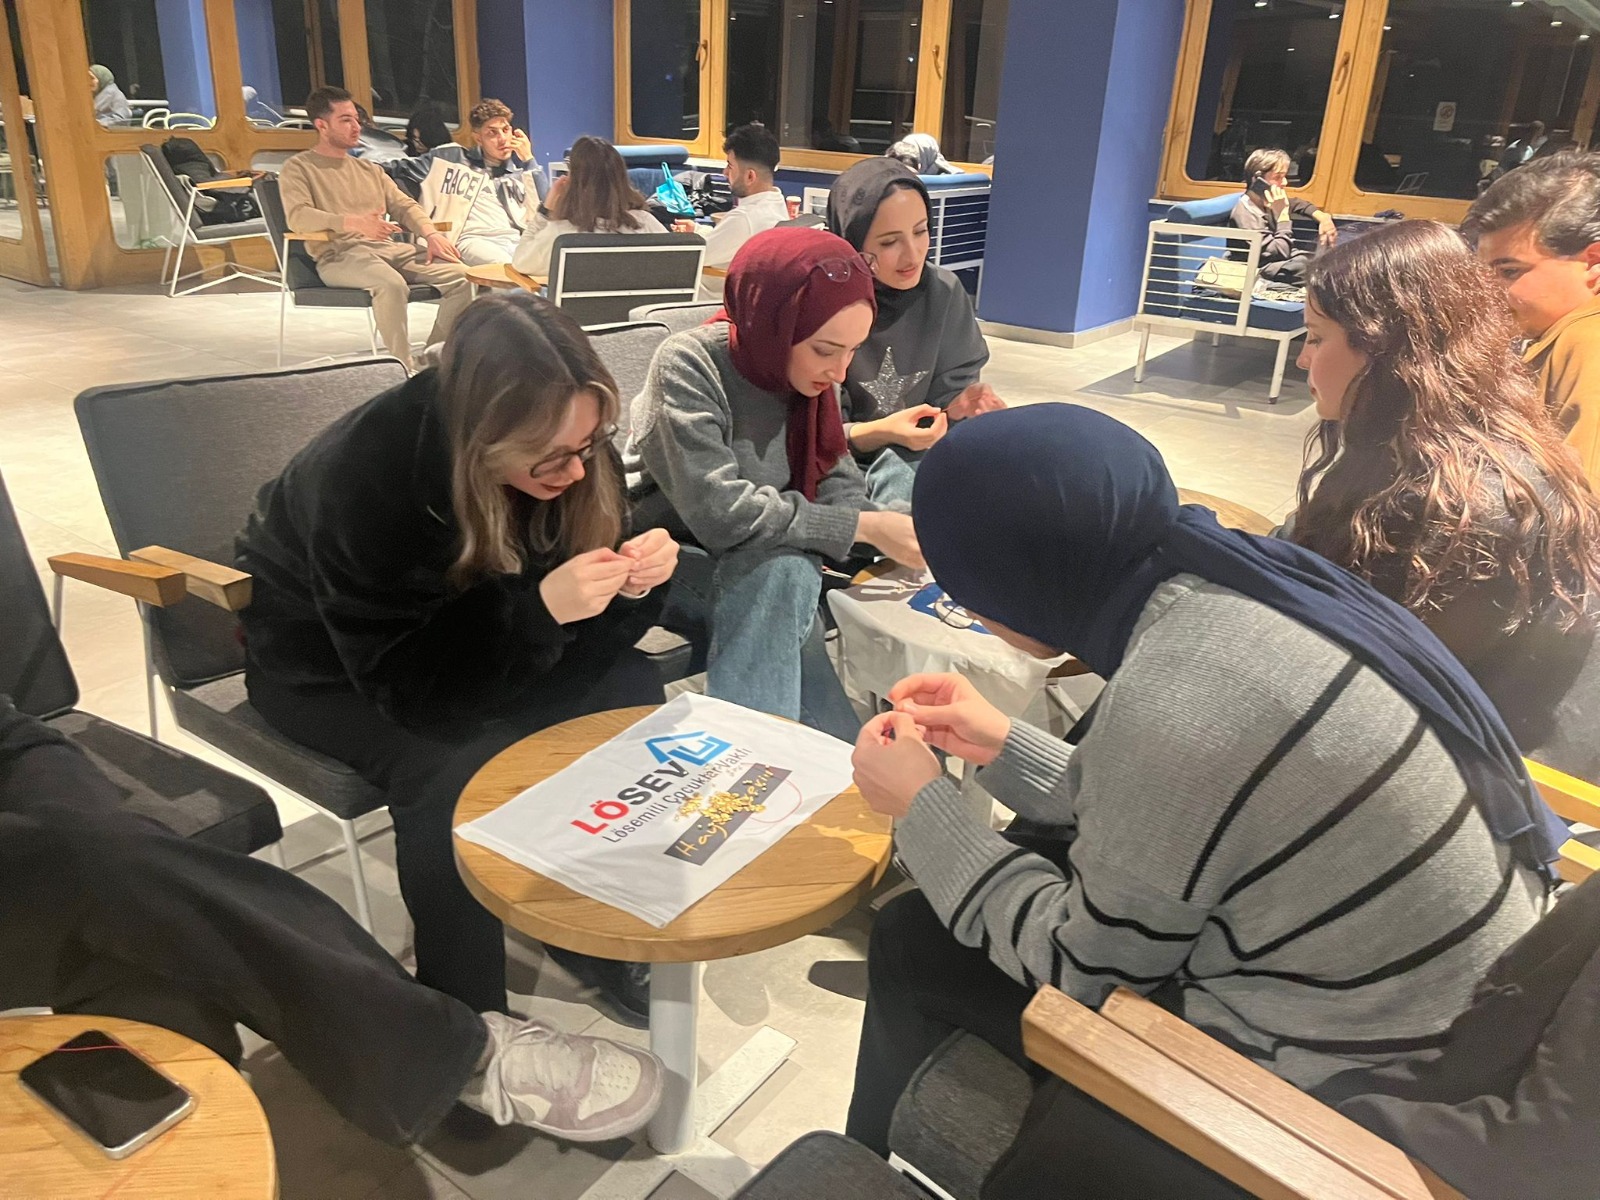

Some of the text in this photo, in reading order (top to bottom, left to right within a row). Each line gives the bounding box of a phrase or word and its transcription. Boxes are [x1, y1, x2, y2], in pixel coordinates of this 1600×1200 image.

[440, 168, 480, 201] RACE
[570, 760, 690, 835] LÖSEV
[602, 803, 668, 843] Lösemili
